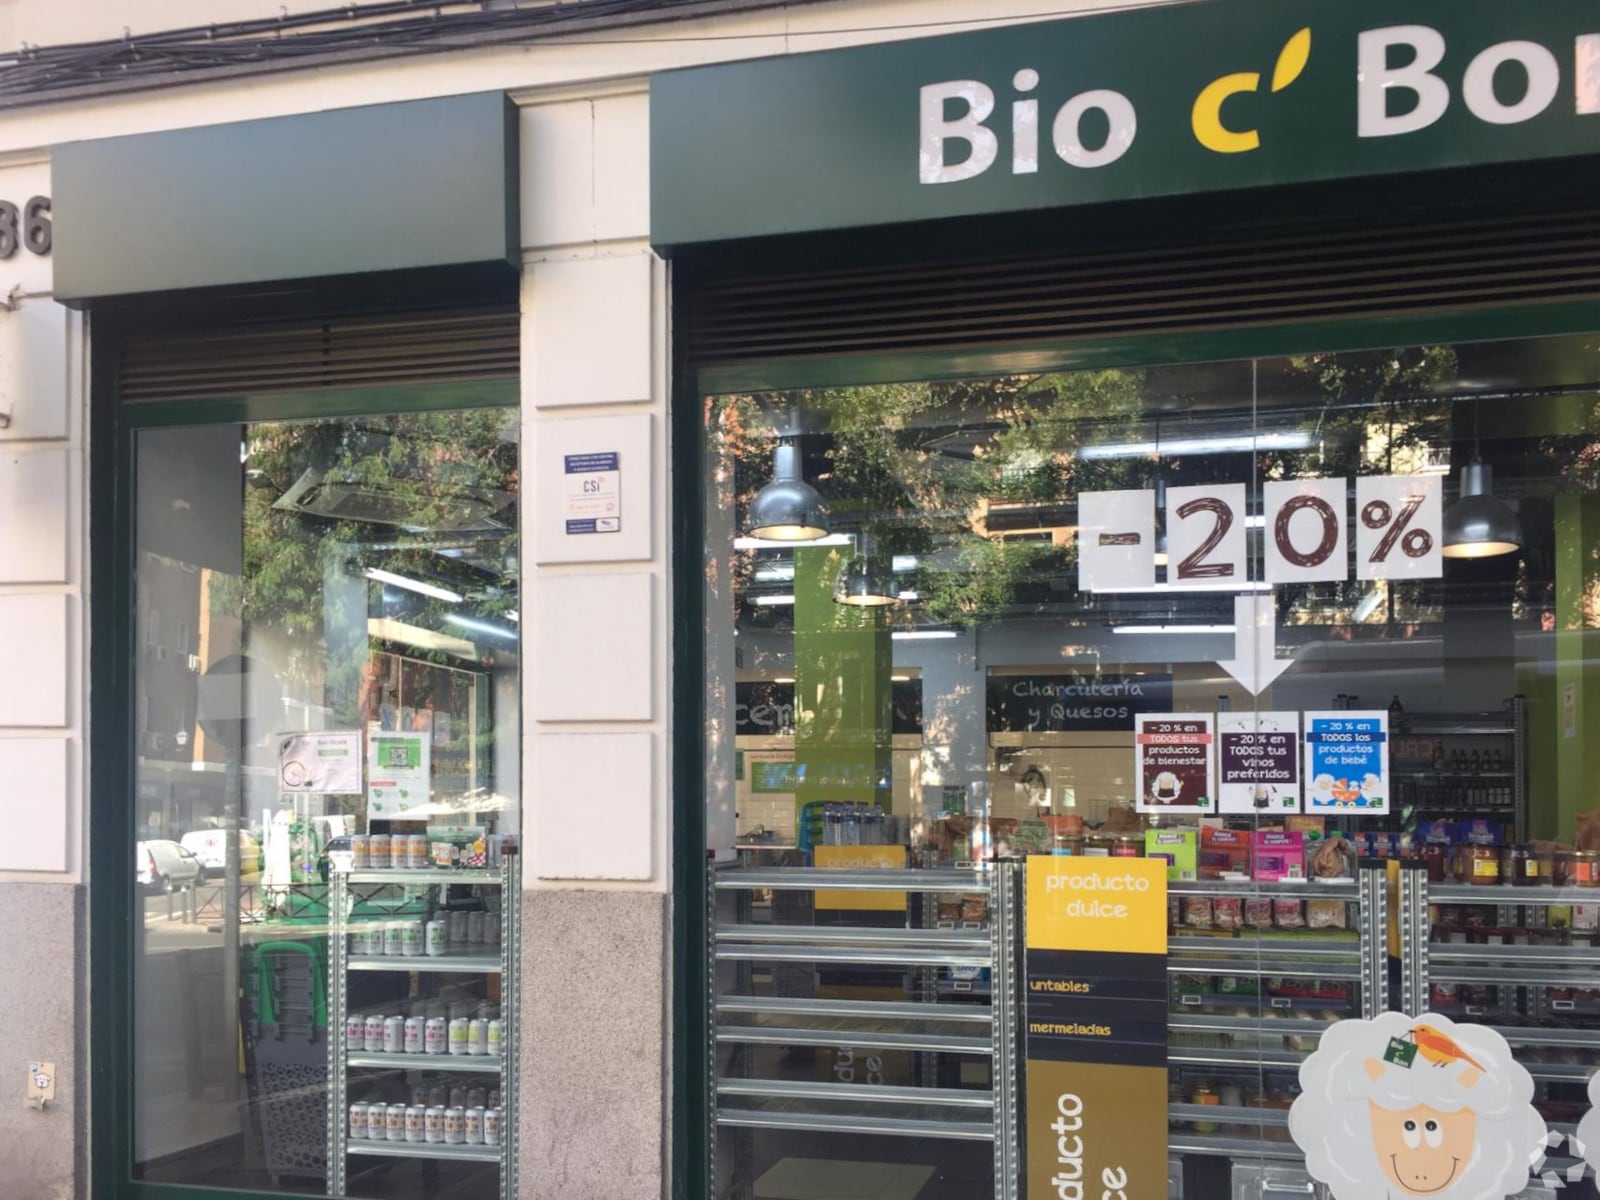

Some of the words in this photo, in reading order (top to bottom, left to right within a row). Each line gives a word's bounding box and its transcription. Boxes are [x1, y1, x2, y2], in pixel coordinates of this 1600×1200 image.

[918, 68, 1137, 184] Bio
[1028, 706, 1041, 727] y
[1050, 703, 1129, 720] Quesos
[1159, 724, 1171, 732] 20
[1329, 722, 1343, 730] 20
[1345, 722, 1354, 730] %
[1150, 735, 1179, 744] TODOS
[1182, 735, 1199, 743] tus
[1240, 735, 1254, 744] 20
[1257, 735, 1266, 744] %
[1270, 736, 1286, 744] en
[1321, 733, 1353, 742] TODOS
[1354, 733, 1371, 742] los
[1148, 746, 1200, 756] productos
[1229, 746, 1264, 755] TODOS
[1267, 746, 1287, 755] tus
[1318, 745, 1374, 755] productos
[1143, 757, 1155, 765] de
[1158, 757, 1206, 765] bienestar
[1242, 758, 1275, 767] vinos
[1324, 756, 1338, 765] de
[1341, 755, 1368, 765] bebé
[1227, 769, 1290, 781] preferidos
[1045, 872, 1150, 894] producto
[1066, 899, 1128, 918] dulce
[1029, 980, 1090, 993] untables
[1029, 1022, 1111, 1036] mermeladas
[1050, 1093, 1083, 1200] ducto
